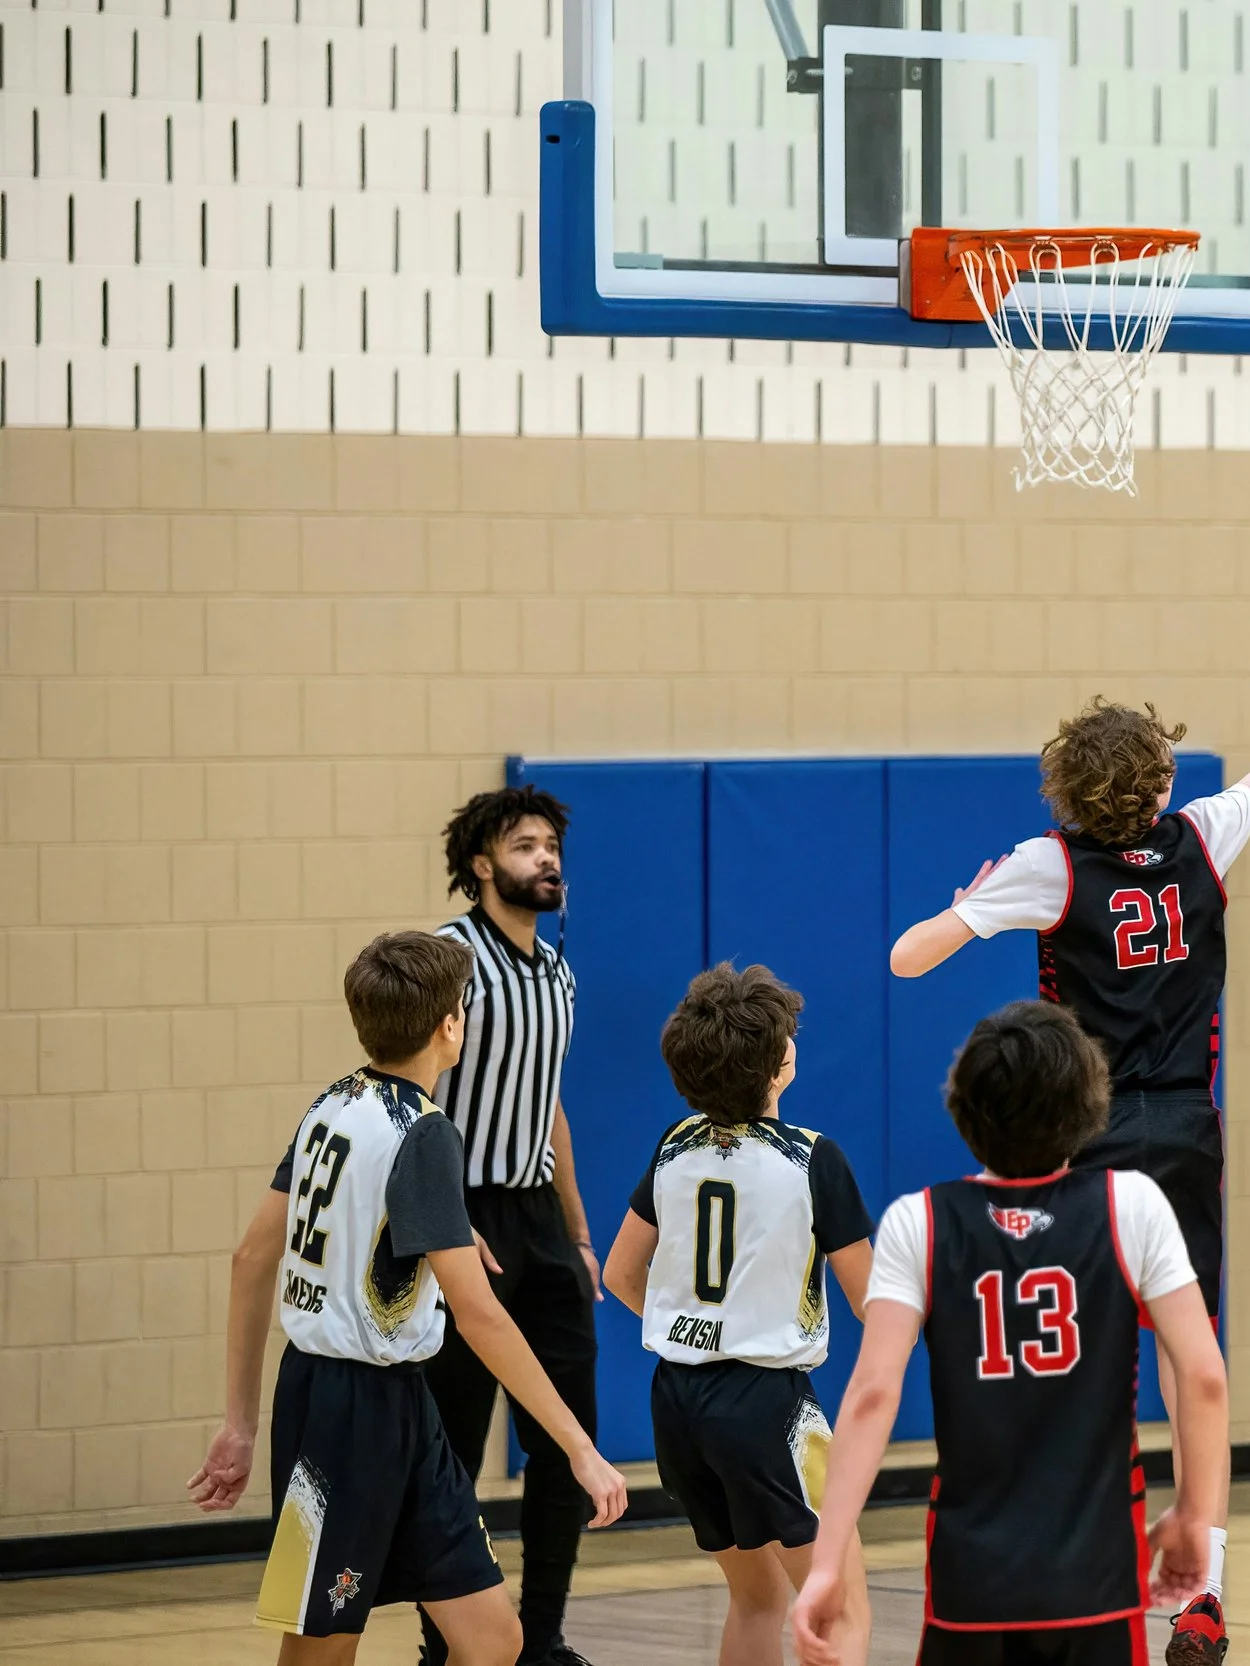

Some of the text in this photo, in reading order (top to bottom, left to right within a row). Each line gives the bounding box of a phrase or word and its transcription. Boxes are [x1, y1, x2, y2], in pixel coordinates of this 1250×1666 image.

[1109, 883, 1190, 970] 21
[693, 1177, 737, 1306] 0
[1004, 1208, 1032, 1239] EP
[974, 1265, 1081, 1380] 13
